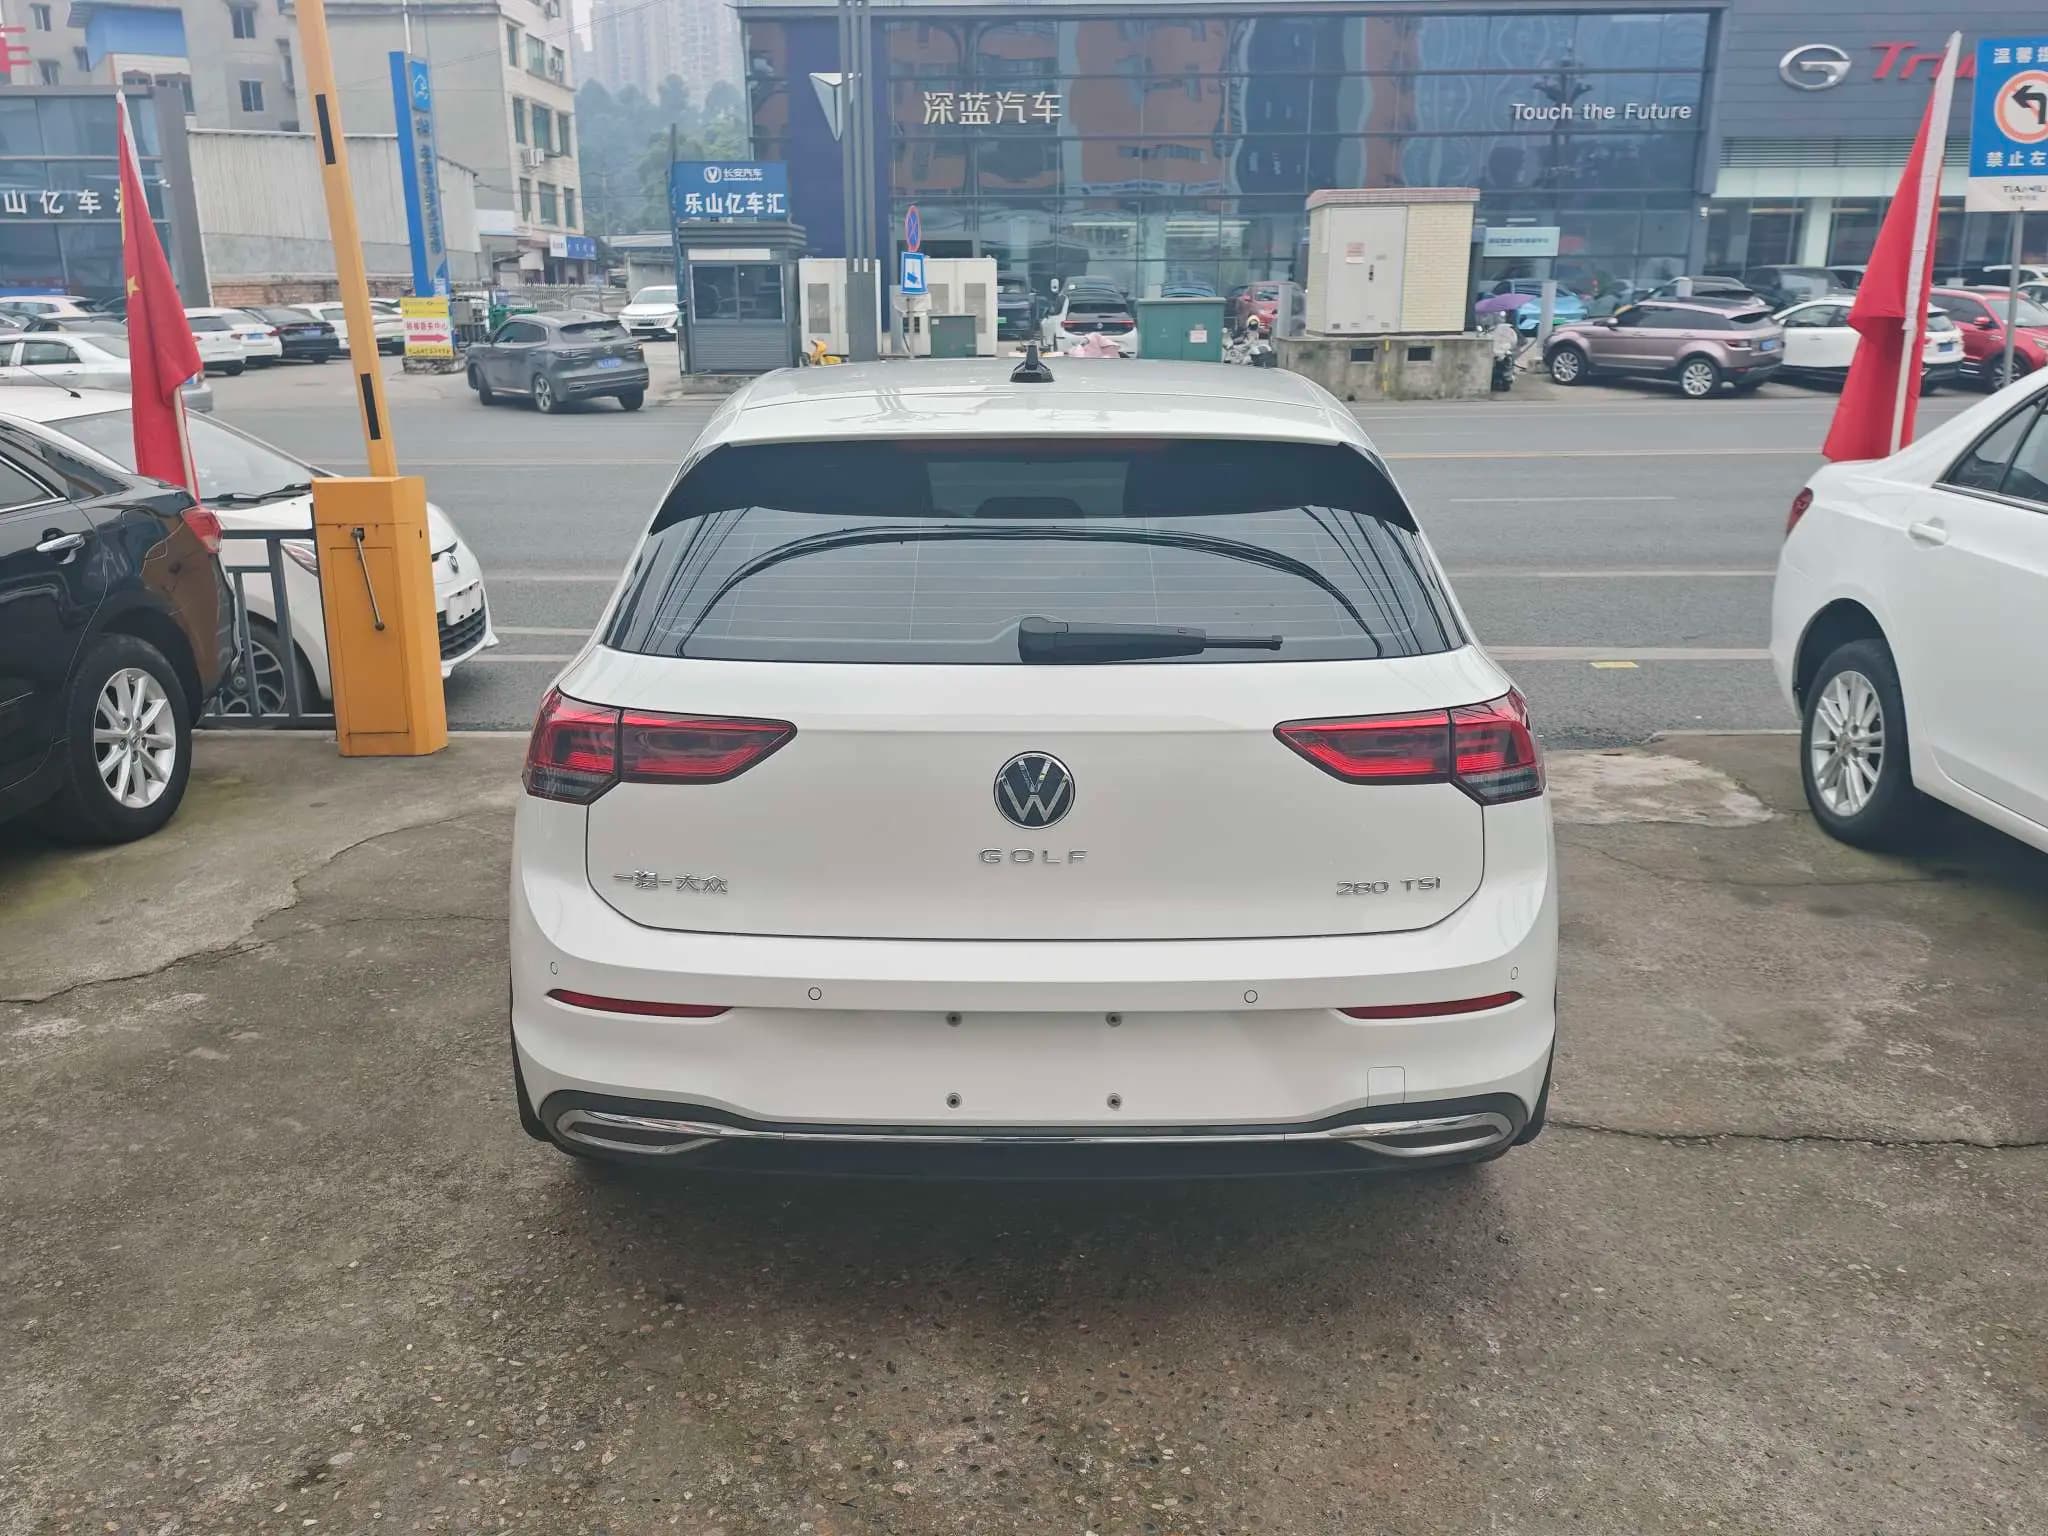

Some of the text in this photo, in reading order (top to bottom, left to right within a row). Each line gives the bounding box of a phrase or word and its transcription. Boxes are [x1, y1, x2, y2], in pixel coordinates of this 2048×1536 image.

[923, 91, 1064, 125] 深蓝汽车
[1513, 103, 1692, 120] Touch the Future
[4, 189, 125, 214] 山亿车
[685, 192, 786, 214] 乐山亿车汇
[979, 848, 1088, 864] GOLF
[1336, 876, 1441, 895] 280 TSI
